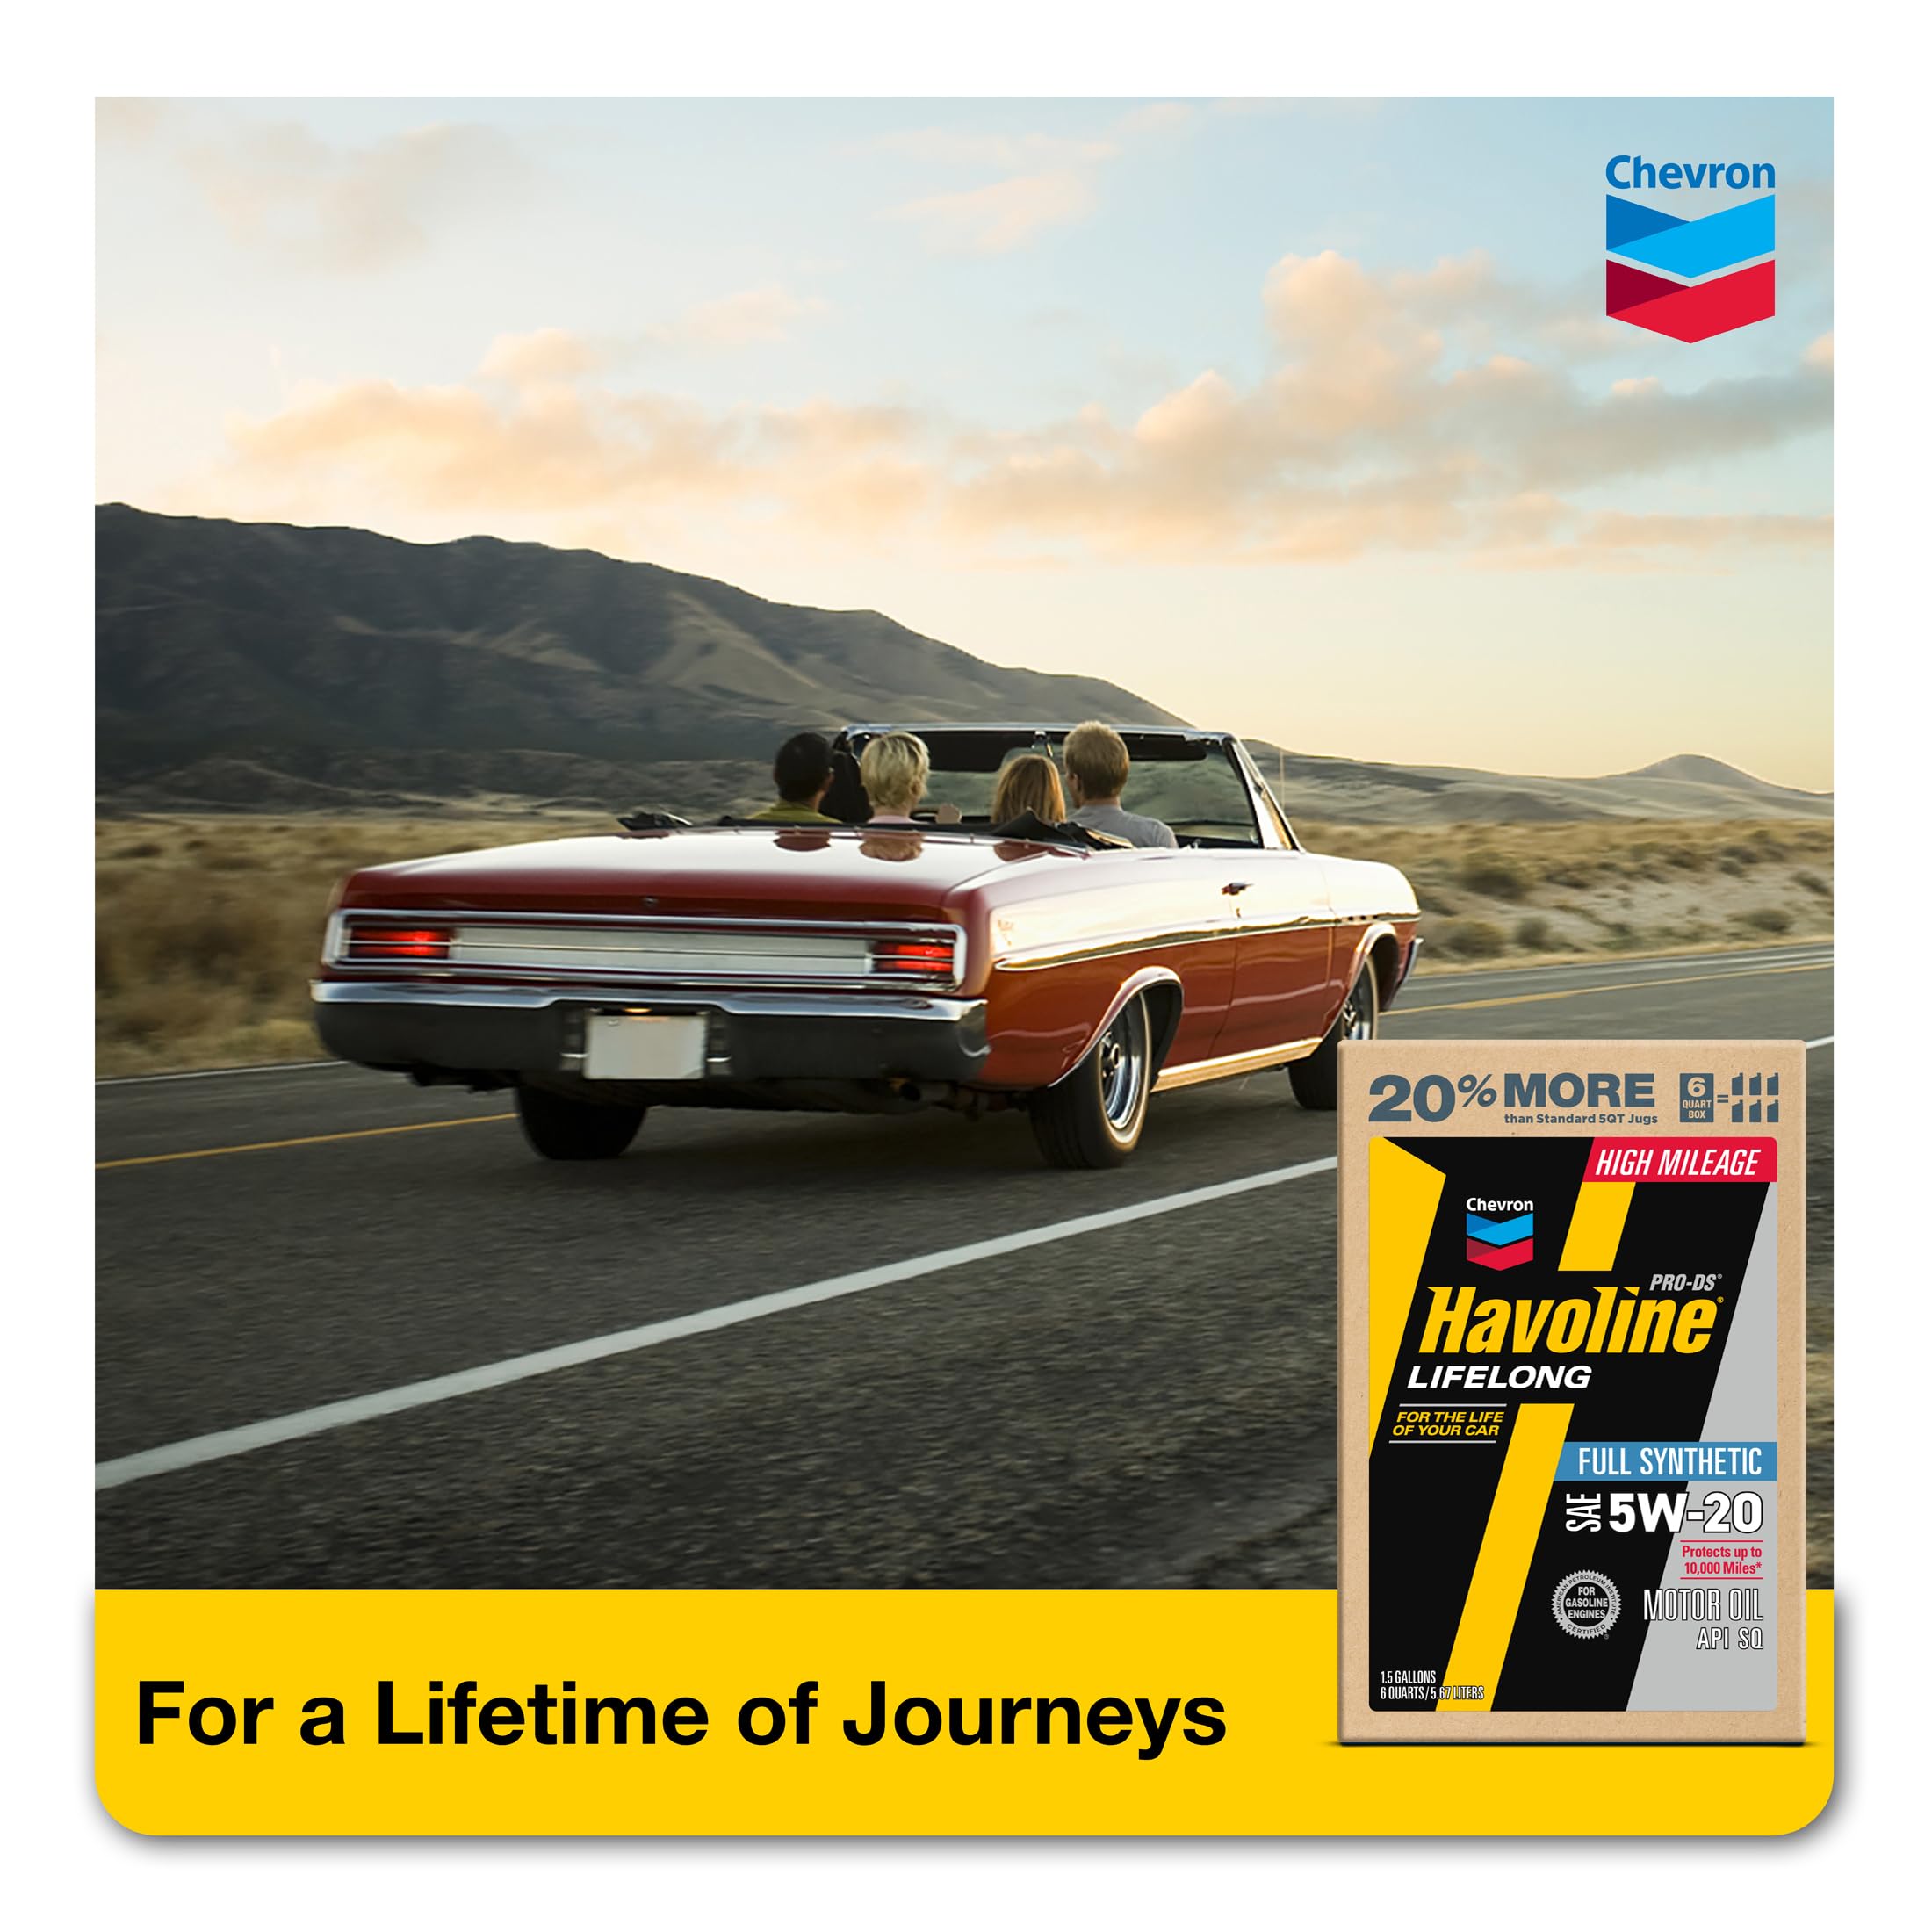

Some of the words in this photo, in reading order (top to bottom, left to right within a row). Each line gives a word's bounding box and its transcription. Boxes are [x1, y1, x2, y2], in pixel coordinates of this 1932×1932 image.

[1687, 1076, 1706, 1098] 6
[1368, 1074, 1497, 1122] 20%
[1503, 1072, 1655, 1108] MORE
[1682, 1099, 1712, 1109] QUART
[1504, 1114, 1534, 1124] than
[1536, 1114, 1596, 1124] Standard
[1599, 1114, 1625, 1125] 5QT
[1627, 1114, 1659, 1126] Jugs
[1688, 1110, 1706, 1120] BOX
[1595, 1150, 1651, 1176] HIGH
[1656, 1149, 1762, 1176] MILEAGE
[1466, 1197, 1534, 1212] Chevron
[1406, 1365, 1592, 1389] LIFELONG
[1396, 1411, 1431, 1423] FOR
[1433, 1411, 1467, 1423] THE
[1468, 1411, 1505, 1423] LIFE
[1392, 1424, 1416, 1436] OF
[1418, 1424, 1462, 1436] YOUR
[1465, 1424, 1500, 1436] CAR
[1578, 1447, 1632, 1475] FULL
[1640, 1447, 1763, 1475] SYNTHETIC
[1565, 1493, 1602, 1532] SAE
[1609, 1491, 1763, 1533] 5W-20
[1682, 1545, 1732, 1558] Protects
[1734, 1548, 1749, 1561] up
[1750, 1546, 1763, 1558] to
[1684, 1561, 1721, 1576] 10,000
[1556, 1583, 1568, 1616] AMERICAN
[1568, 1575, 1606, 1585] PETROLEUM
[1604, 1584, 1617, 1615] INSTITUTE
[1578, 1586, 1596, 1596] FOR
[1565, 1598, 1609, 1608] GASOLINE
[1643, 1589, 1720, 1621] MOTOR
[1728, 1589, 1763, 1621] OIL
[1568, 1610, 1606, 1619] ENGINES
[1567, 1623, 1606, 1634] CERTIFIED
[1696, 1627, 1729, 1649] API
[1738, 1627, 1763, 1649] SQ
[1381, 1670, 1393, 1684] 1.5
[1395, 1670, 1437, 1684] GALLONS
[1381, 1686, 1387, 1700] 6
[1453, 1686, 1485, 1700] LITERS
